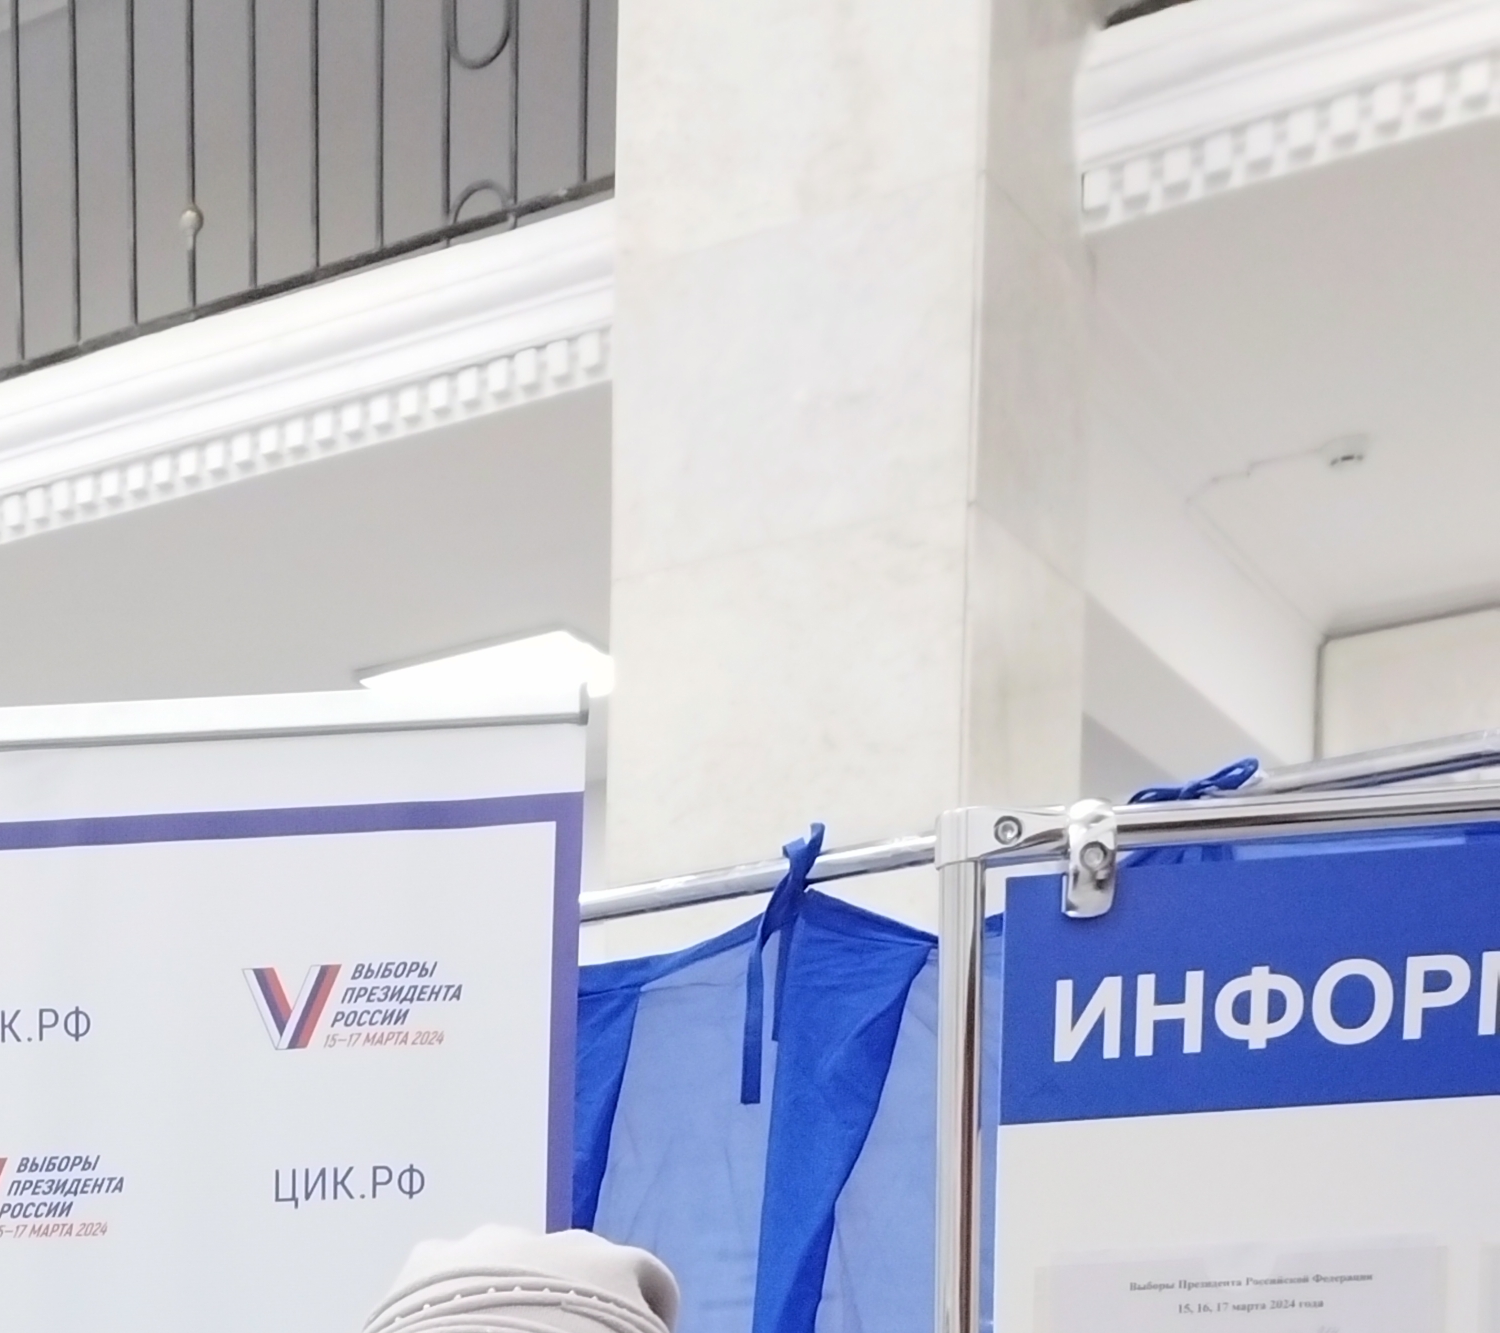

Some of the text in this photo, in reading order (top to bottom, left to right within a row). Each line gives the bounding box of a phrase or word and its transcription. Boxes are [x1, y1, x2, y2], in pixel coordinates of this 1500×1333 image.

[350, 961, 438, 980] ВЫБОРЫ
[341, 984, 463, 1004] ПРЕЗИДЕНТА
[1054, 951, 1500, 1062] ИНФОР
[330, 1008, 410, 1028] РОССИИ
[362, 1031, 409, 1046] МАРТА
[411, 1030, 445, 1046] 2024
[16, 1155, 100, 1173] ВЫБОРЫ
[7, 1176, 124, 1197] ПРЕЗИДЕНТА
[274, 1163, 425, 1209] ЦИК.РФ
[28, 1223, 74, 1238] МАРТА
[75, 1222, 108, 1238] 2024
